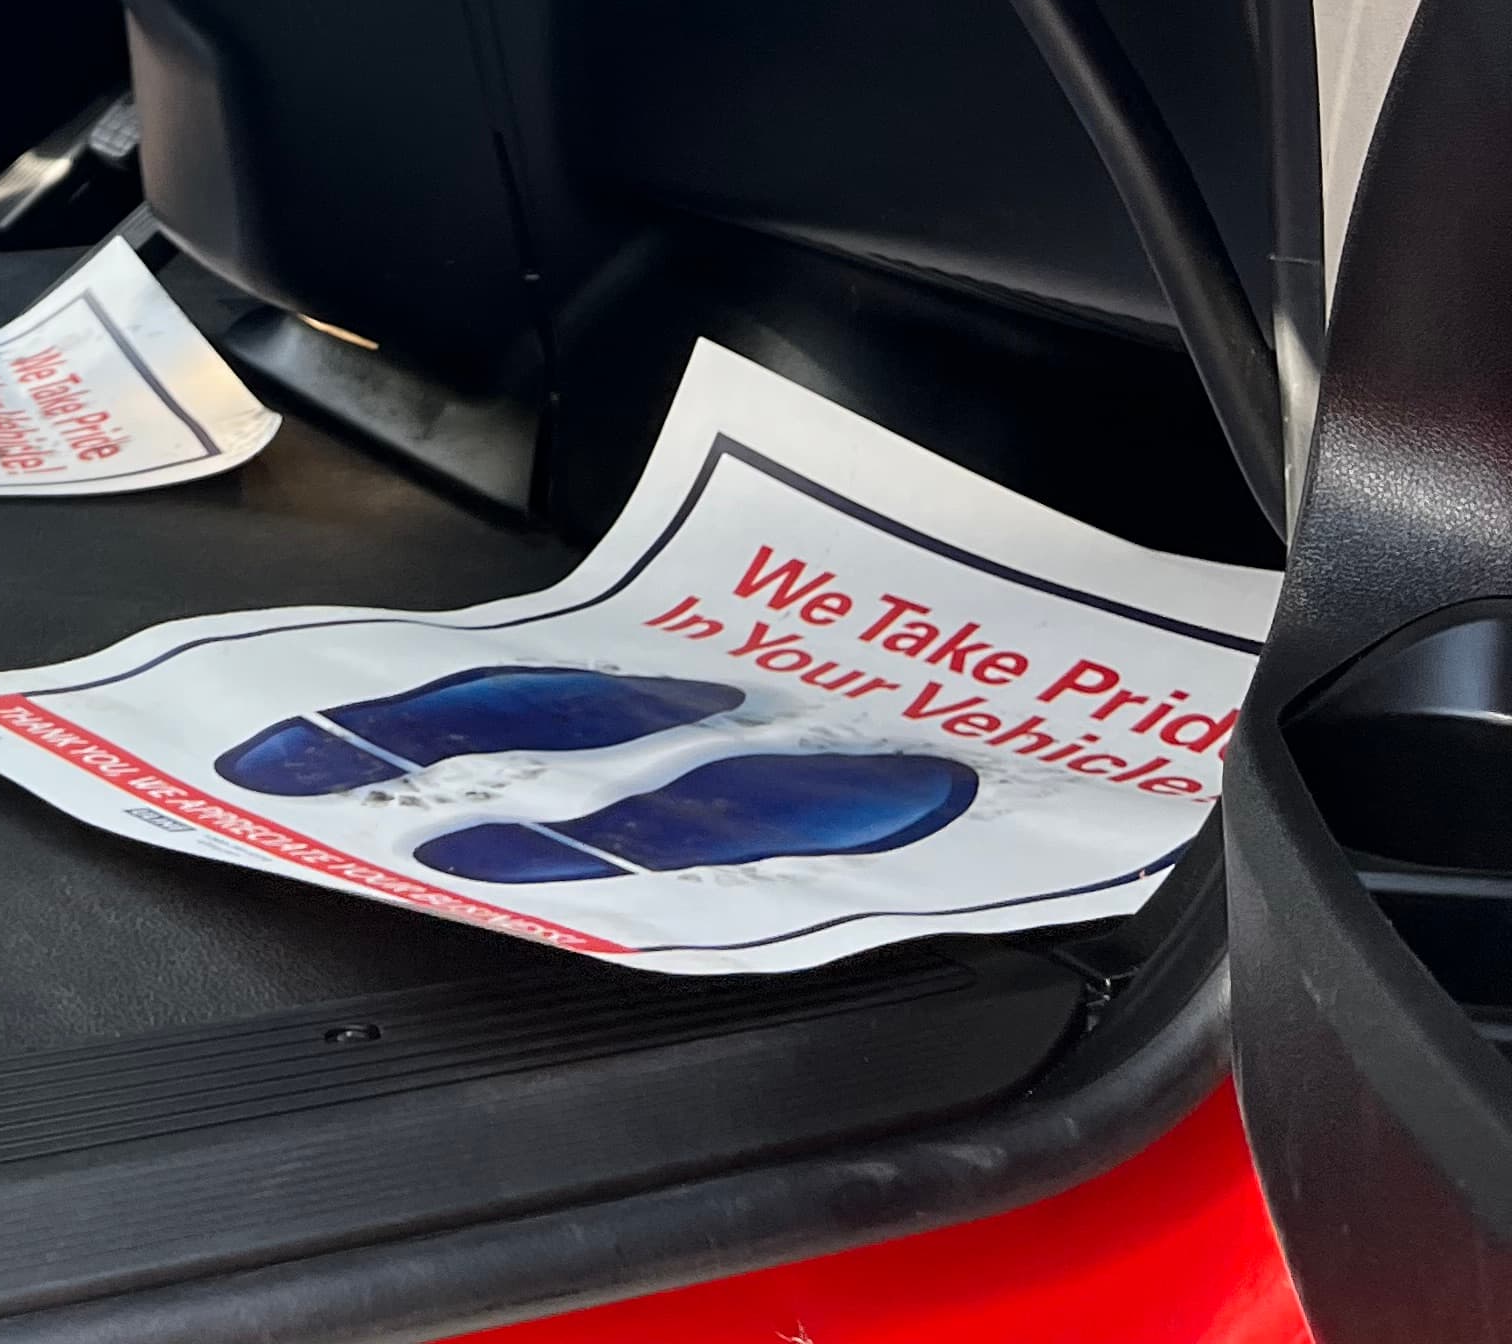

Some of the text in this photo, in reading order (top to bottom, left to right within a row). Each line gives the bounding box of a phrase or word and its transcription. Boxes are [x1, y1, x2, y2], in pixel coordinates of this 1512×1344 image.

[9, 345, 132, 461] We Take Pride
[641, 596, 724, 639] In
[727, 621, 901, 698] Your
[733, 545, 1241, 762] We Take Prid
[128, 775, 188, 799] WE
